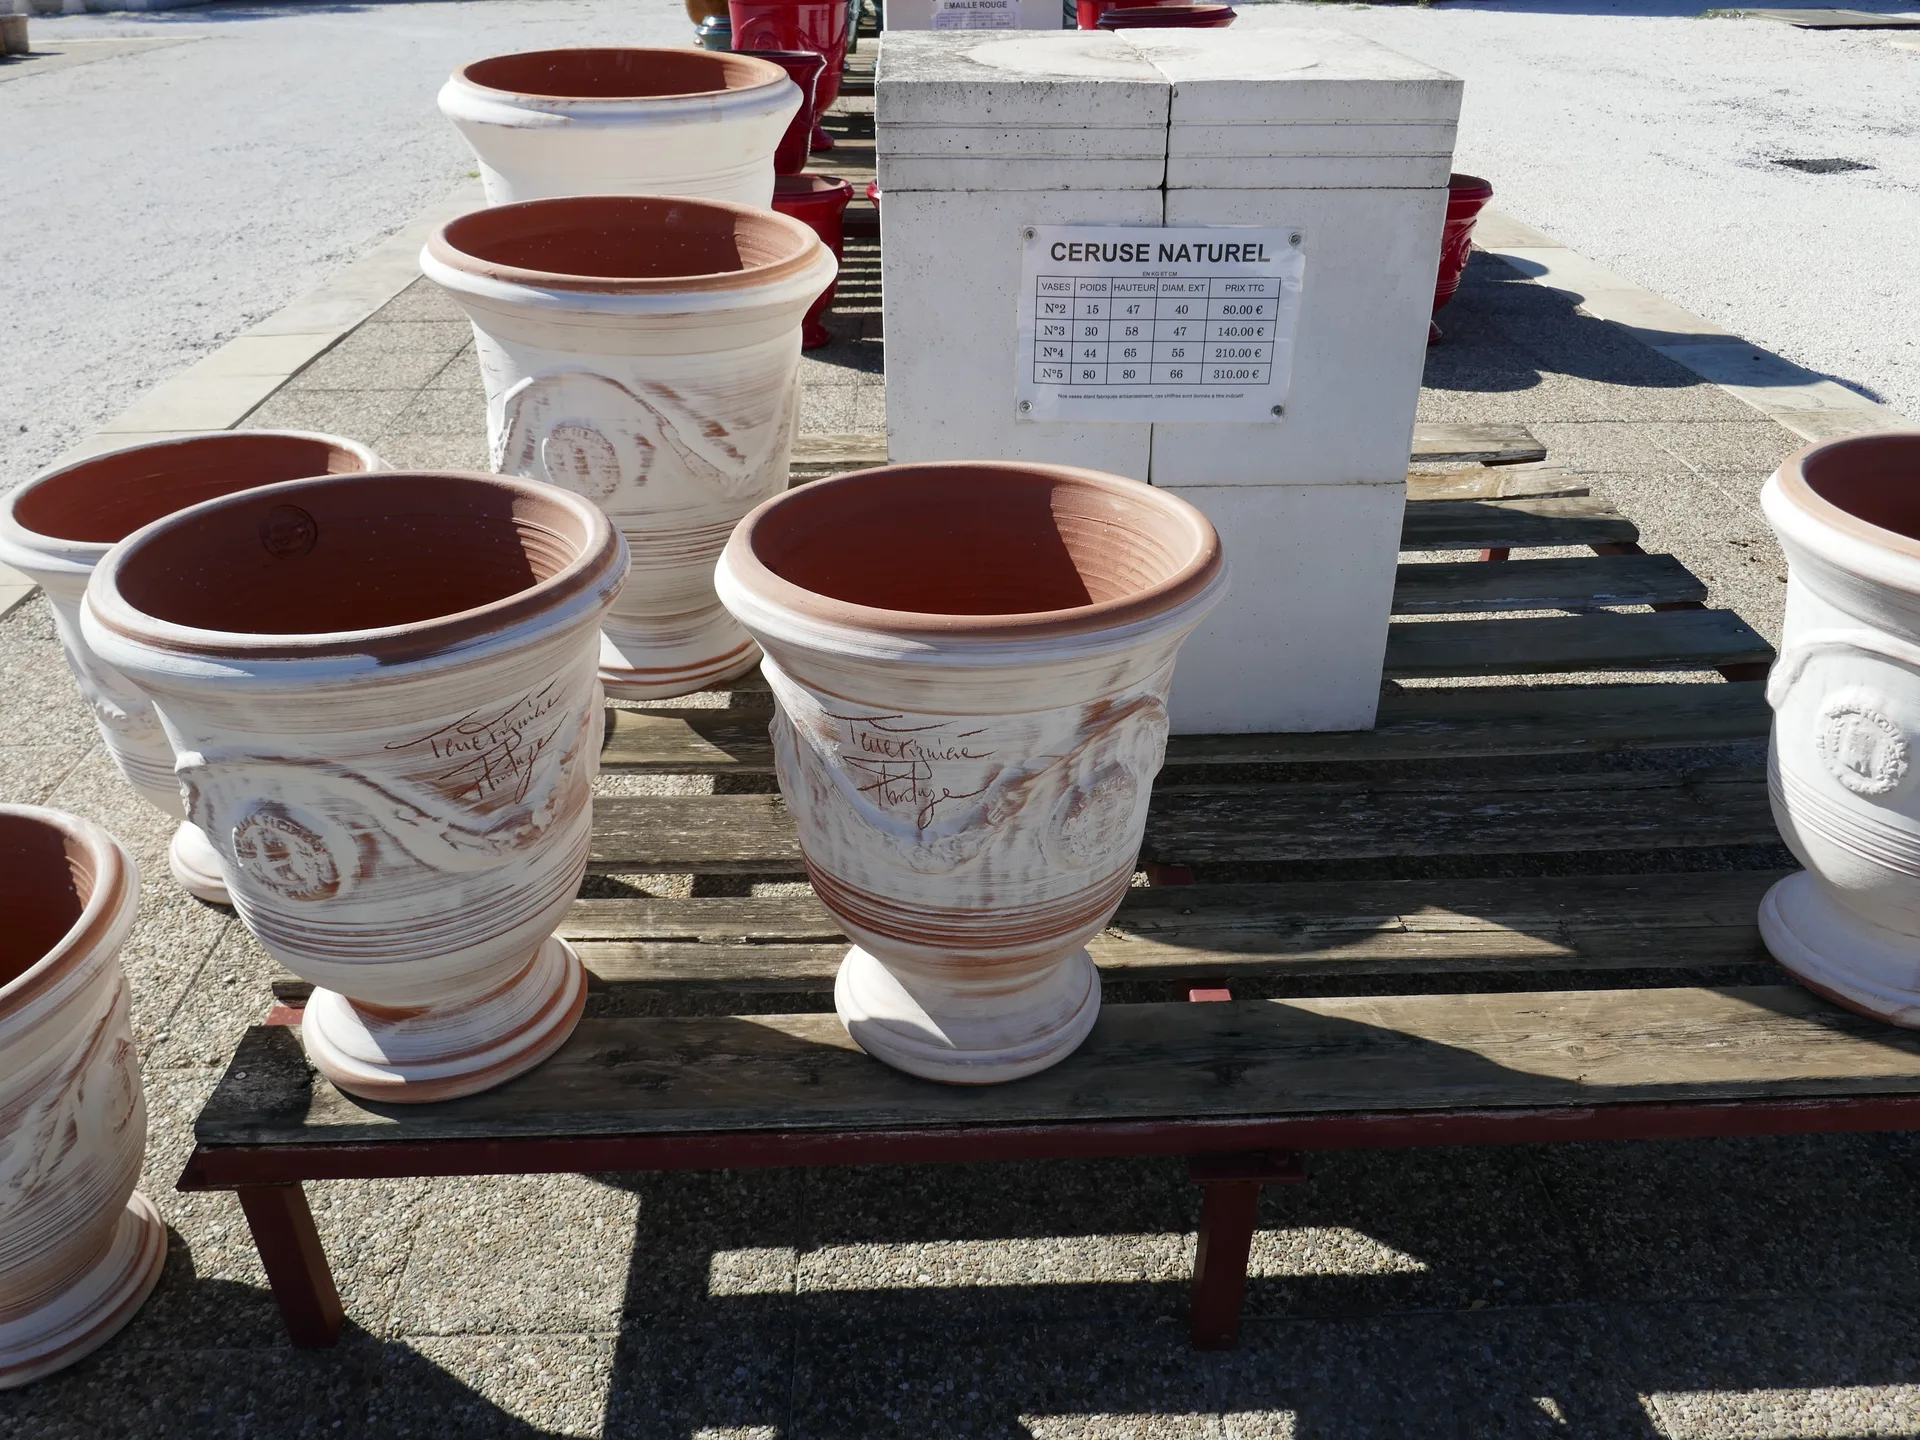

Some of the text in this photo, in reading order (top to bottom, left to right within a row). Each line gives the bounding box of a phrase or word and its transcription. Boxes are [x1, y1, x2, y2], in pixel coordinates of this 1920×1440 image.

[944, 1, 977, 9] EMAILLE
[1050, 242, 1271, 263] CERUSE NATUREL
[1041, 283, 1265, 292] VASES POIDS HAUTEUR DIAM. EXT PRIX TTC
[1044, 303, 1263, 315] N°2 15 47 40 80.00 €
[1043, 325, 1264, 337] N°3 30 58 47 140.00 €
[1043, 347, 1262, 358] N°4 44 65 55 210.00 €
[1042, 368, 1259, 380] N°5 80 80 66 310.00 €
